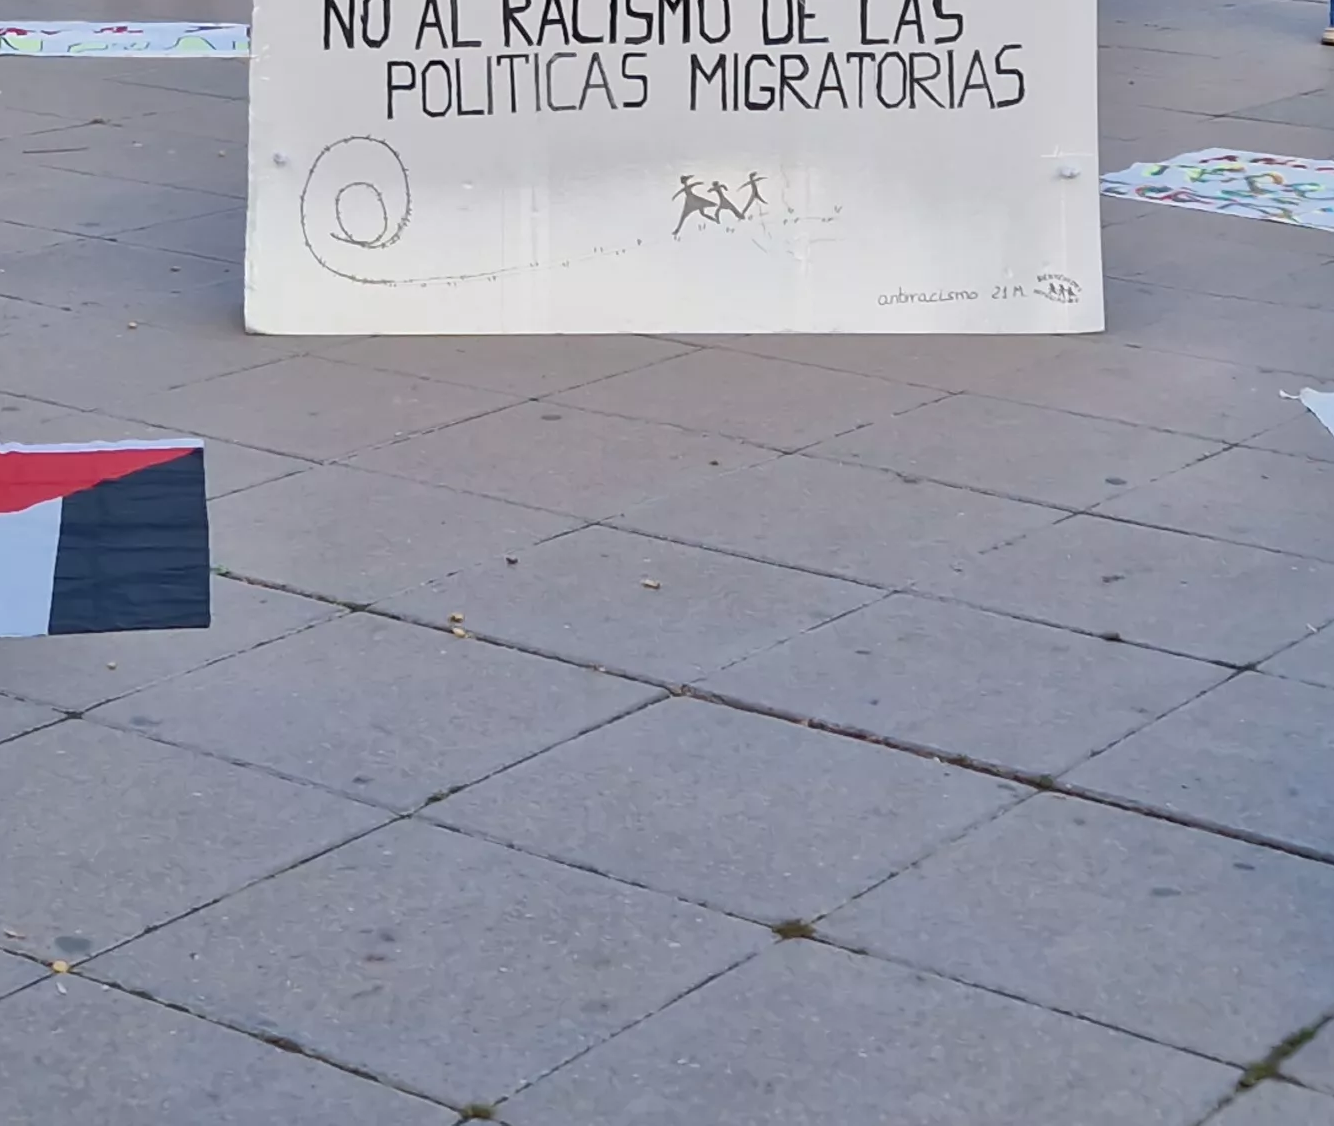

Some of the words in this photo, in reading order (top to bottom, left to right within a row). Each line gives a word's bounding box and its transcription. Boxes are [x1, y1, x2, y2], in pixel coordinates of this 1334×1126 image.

[386, 51, 649, 120] POLITICAS
[689, 43, 1026, 112] MIGRATORIAS
[991, 285, 1008, 300] 21
